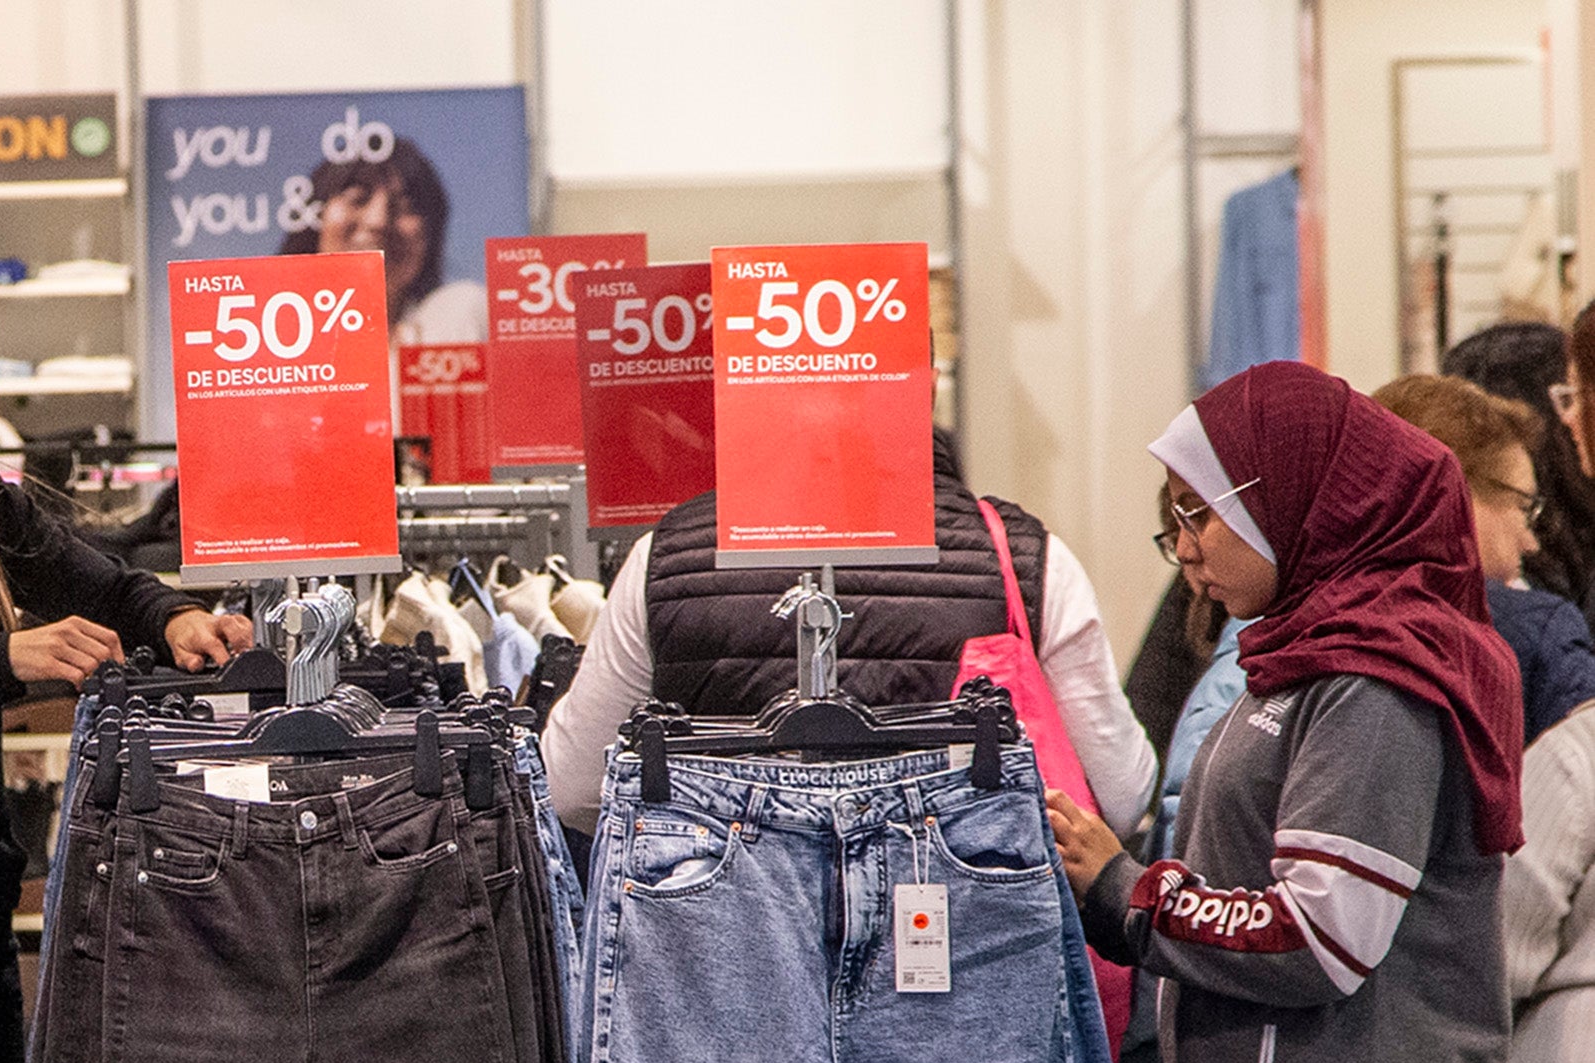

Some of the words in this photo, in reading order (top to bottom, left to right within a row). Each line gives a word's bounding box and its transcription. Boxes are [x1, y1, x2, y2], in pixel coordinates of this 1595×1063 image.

[164, 124, 272, 181] you
[321, 104, 396, 165] do
[170, 191, 269, 248] you
[276, 174, 325, 233] &
[496, 248, 543, 261] HASTA
[727, 262, 788, 278] HASTA
[184, 275, 245, 293] HASTA
[586, 282, 637, 297] HASTA
[726, 278, 907, 348] -50%
[184, 288, 364, 362] -50%
[589, 362, 612, 377] DE
[614, 356, 714, 376] DESCUENTO
[727, 356, 754, 373] DE
[757, 353, 877, 372] DESCUENTO
[187, 370, 213, 388] DE
[217, 363, 336, 386] DESCUENTO
[1248, 712, 1282, 736] adidas
[779, 767, 887, 785] CLOCKHOUSE
